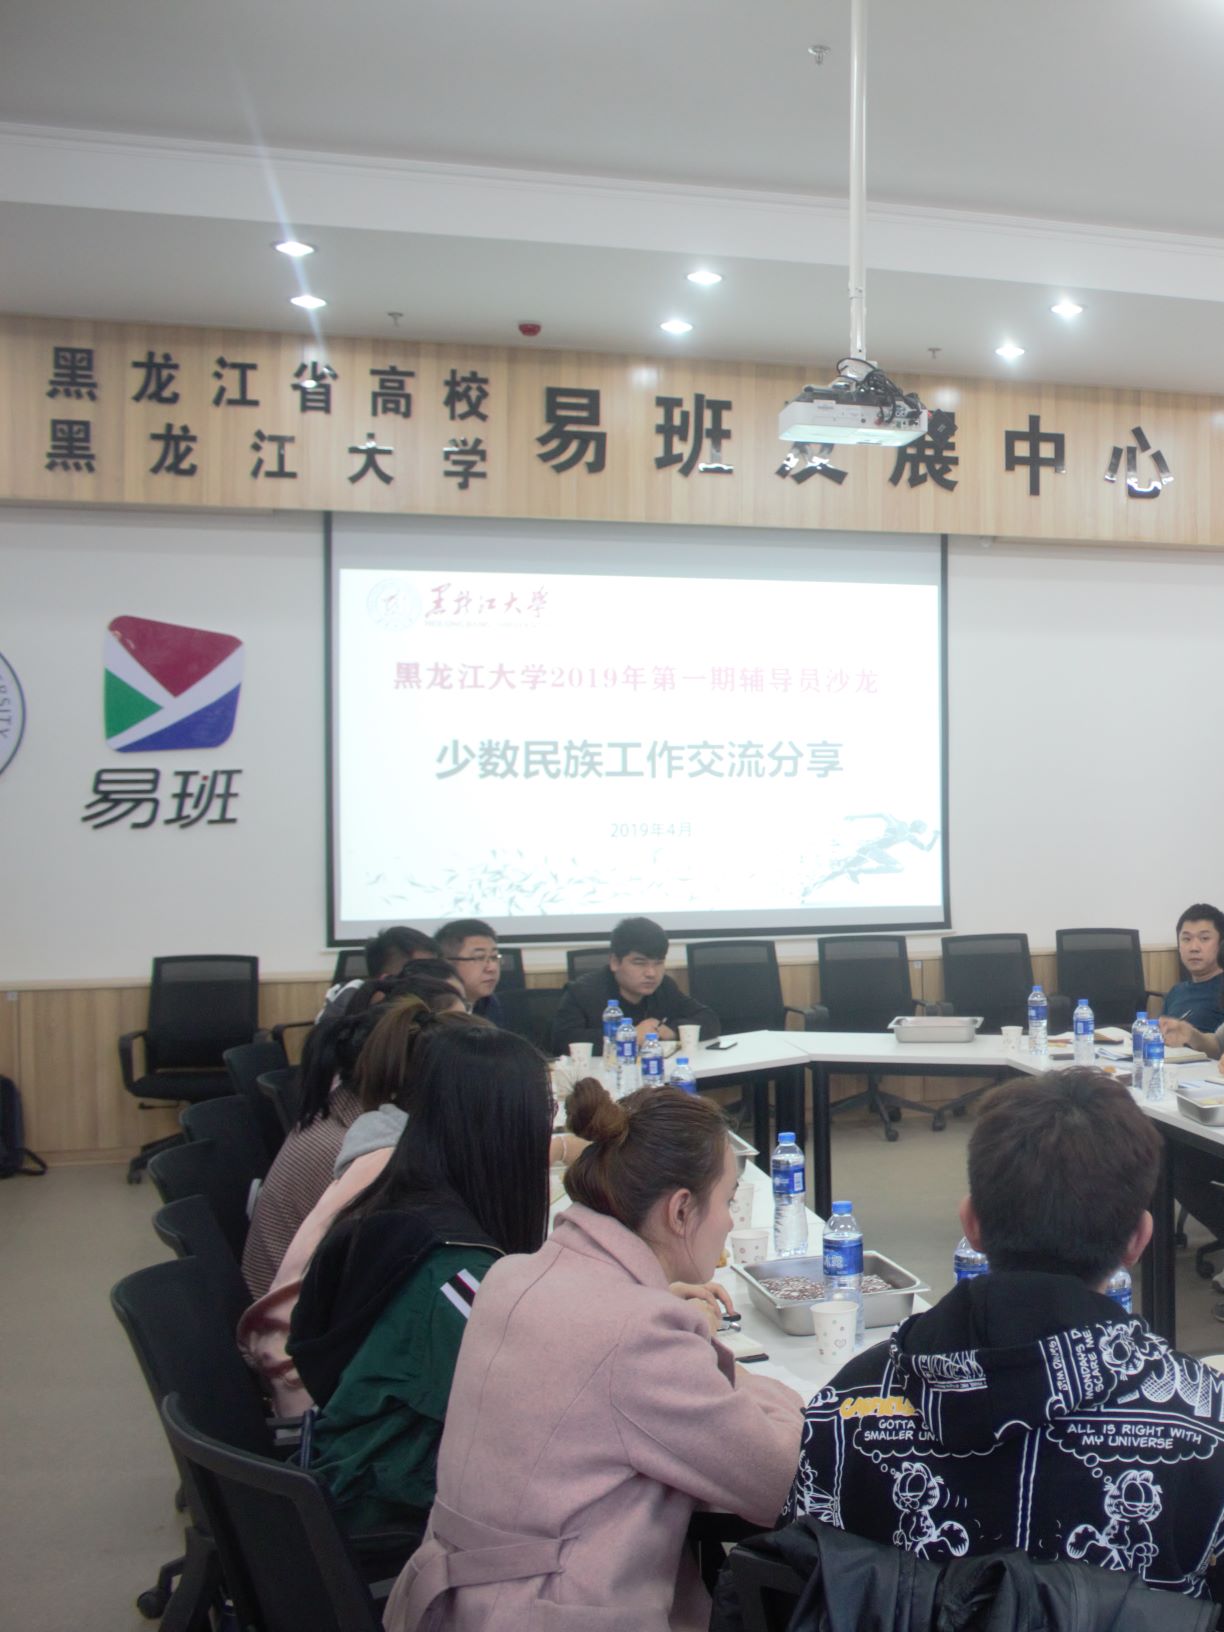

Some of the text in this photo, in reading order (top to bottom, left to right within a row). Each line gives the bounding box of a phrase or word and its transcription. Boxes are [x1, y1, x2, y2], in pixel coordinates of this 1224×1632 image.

[48, 346, 490, 422] 黑龙江省高校
[45, 418, 488, 490] 黑龙江大学
[393, 661, 880, 695] 黑龙江大学2019年第一期辅导员沙龙
[436, 739, 844, 781] 少数民族工作交流分享
[81, 767, 243, 830] 易班
[610, 820, 694, 840] 2019年4月
[1088, 1352, 1104, 1393] SCARE
[864, 1430, 914, 1441] SMALLER
[878, 1419, 915, 1430] GOTTA
[1067, 1423, 1202, 1445] ALL IS RIGHT WITH
[1082, 1435, 1174, 1449] MY UNIVERSE
